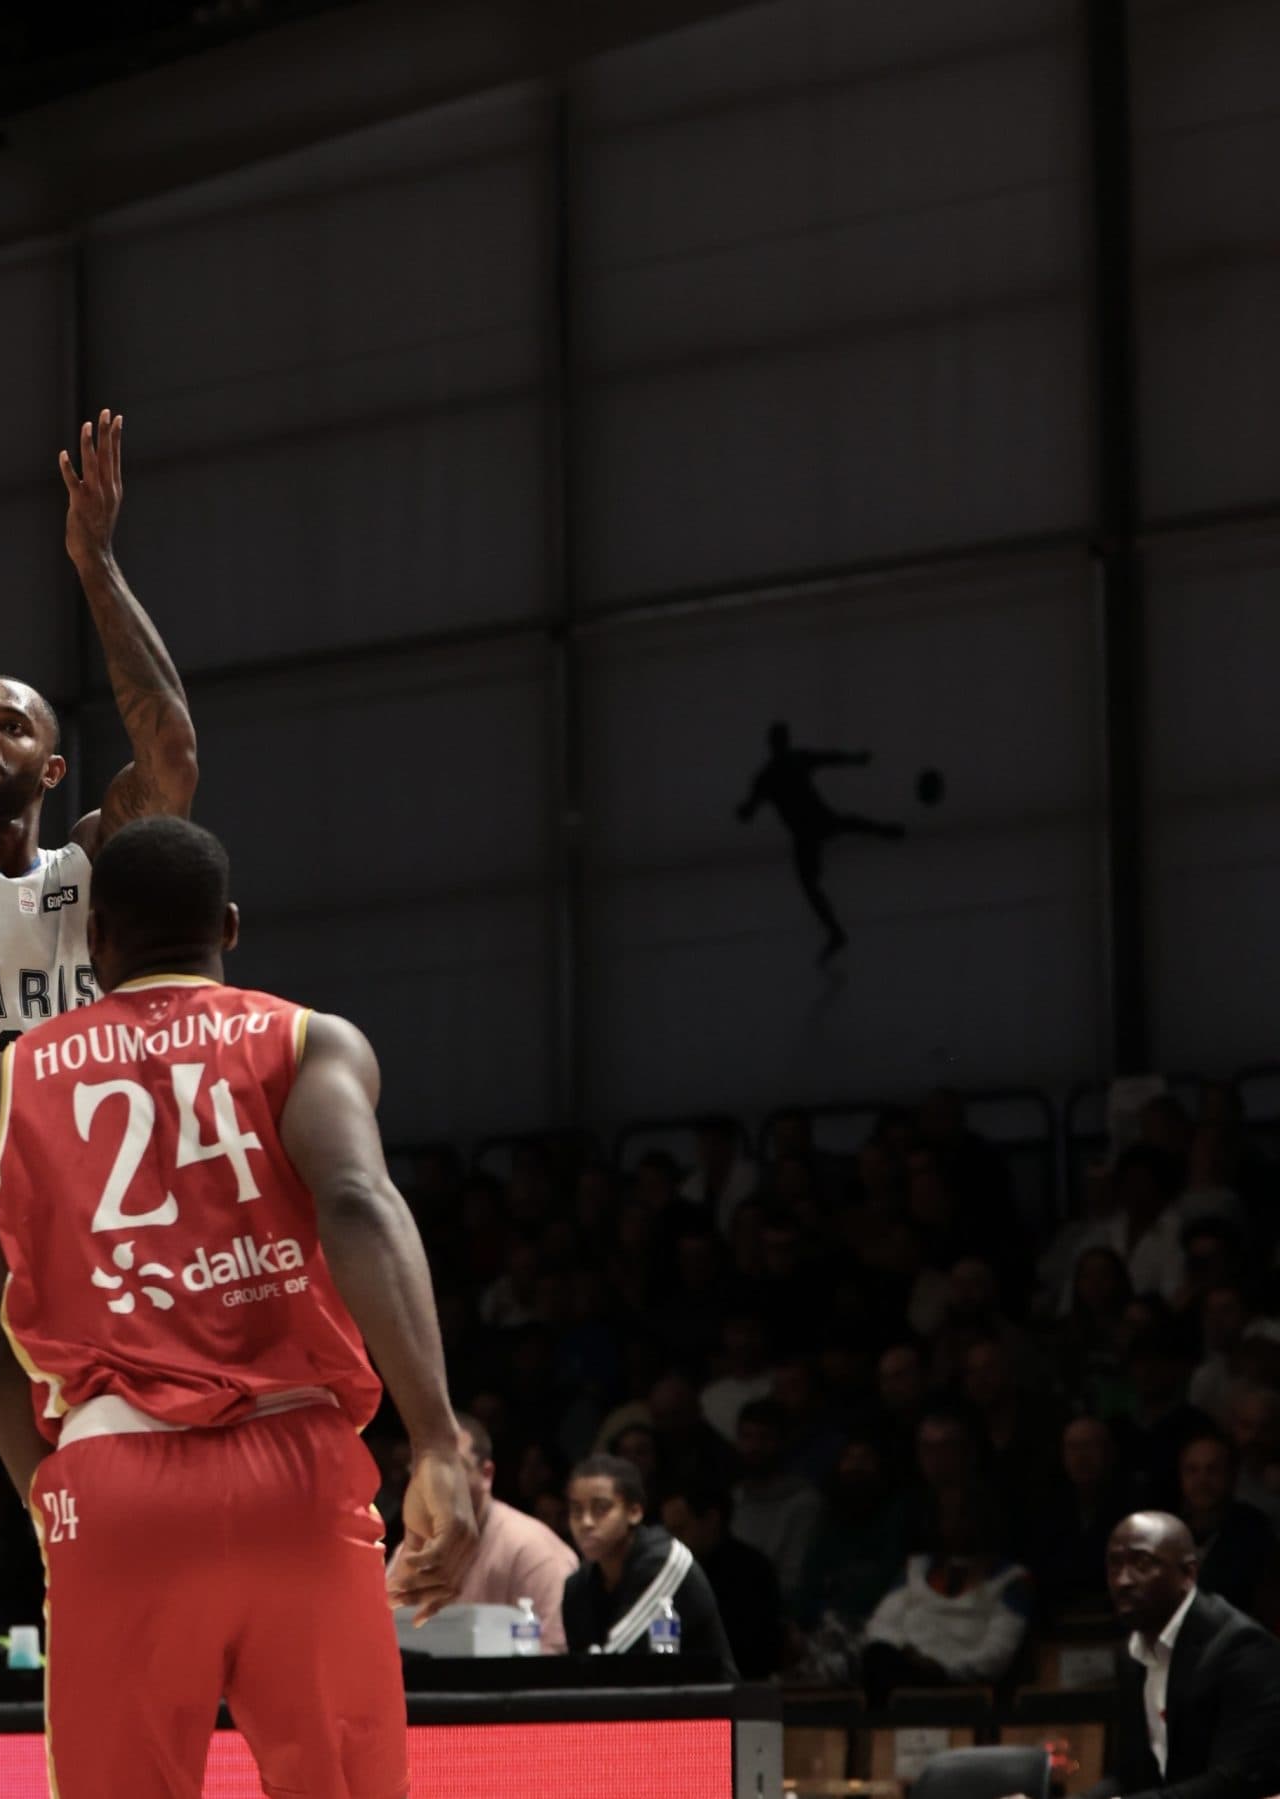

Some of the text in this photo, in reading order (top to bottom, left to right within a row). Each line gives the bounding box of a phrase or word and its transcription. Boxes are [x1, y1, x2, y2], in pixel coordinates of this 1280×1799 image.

[33, 1011, 275, 1081] HOUMOUNOU
[73, 1062, 264, 1234] 24
[181, 1231, 305, 1291] dalkia
[222, 1282, 282, 1308] GROUPE
[41, 1488, 80, 1544] 24
